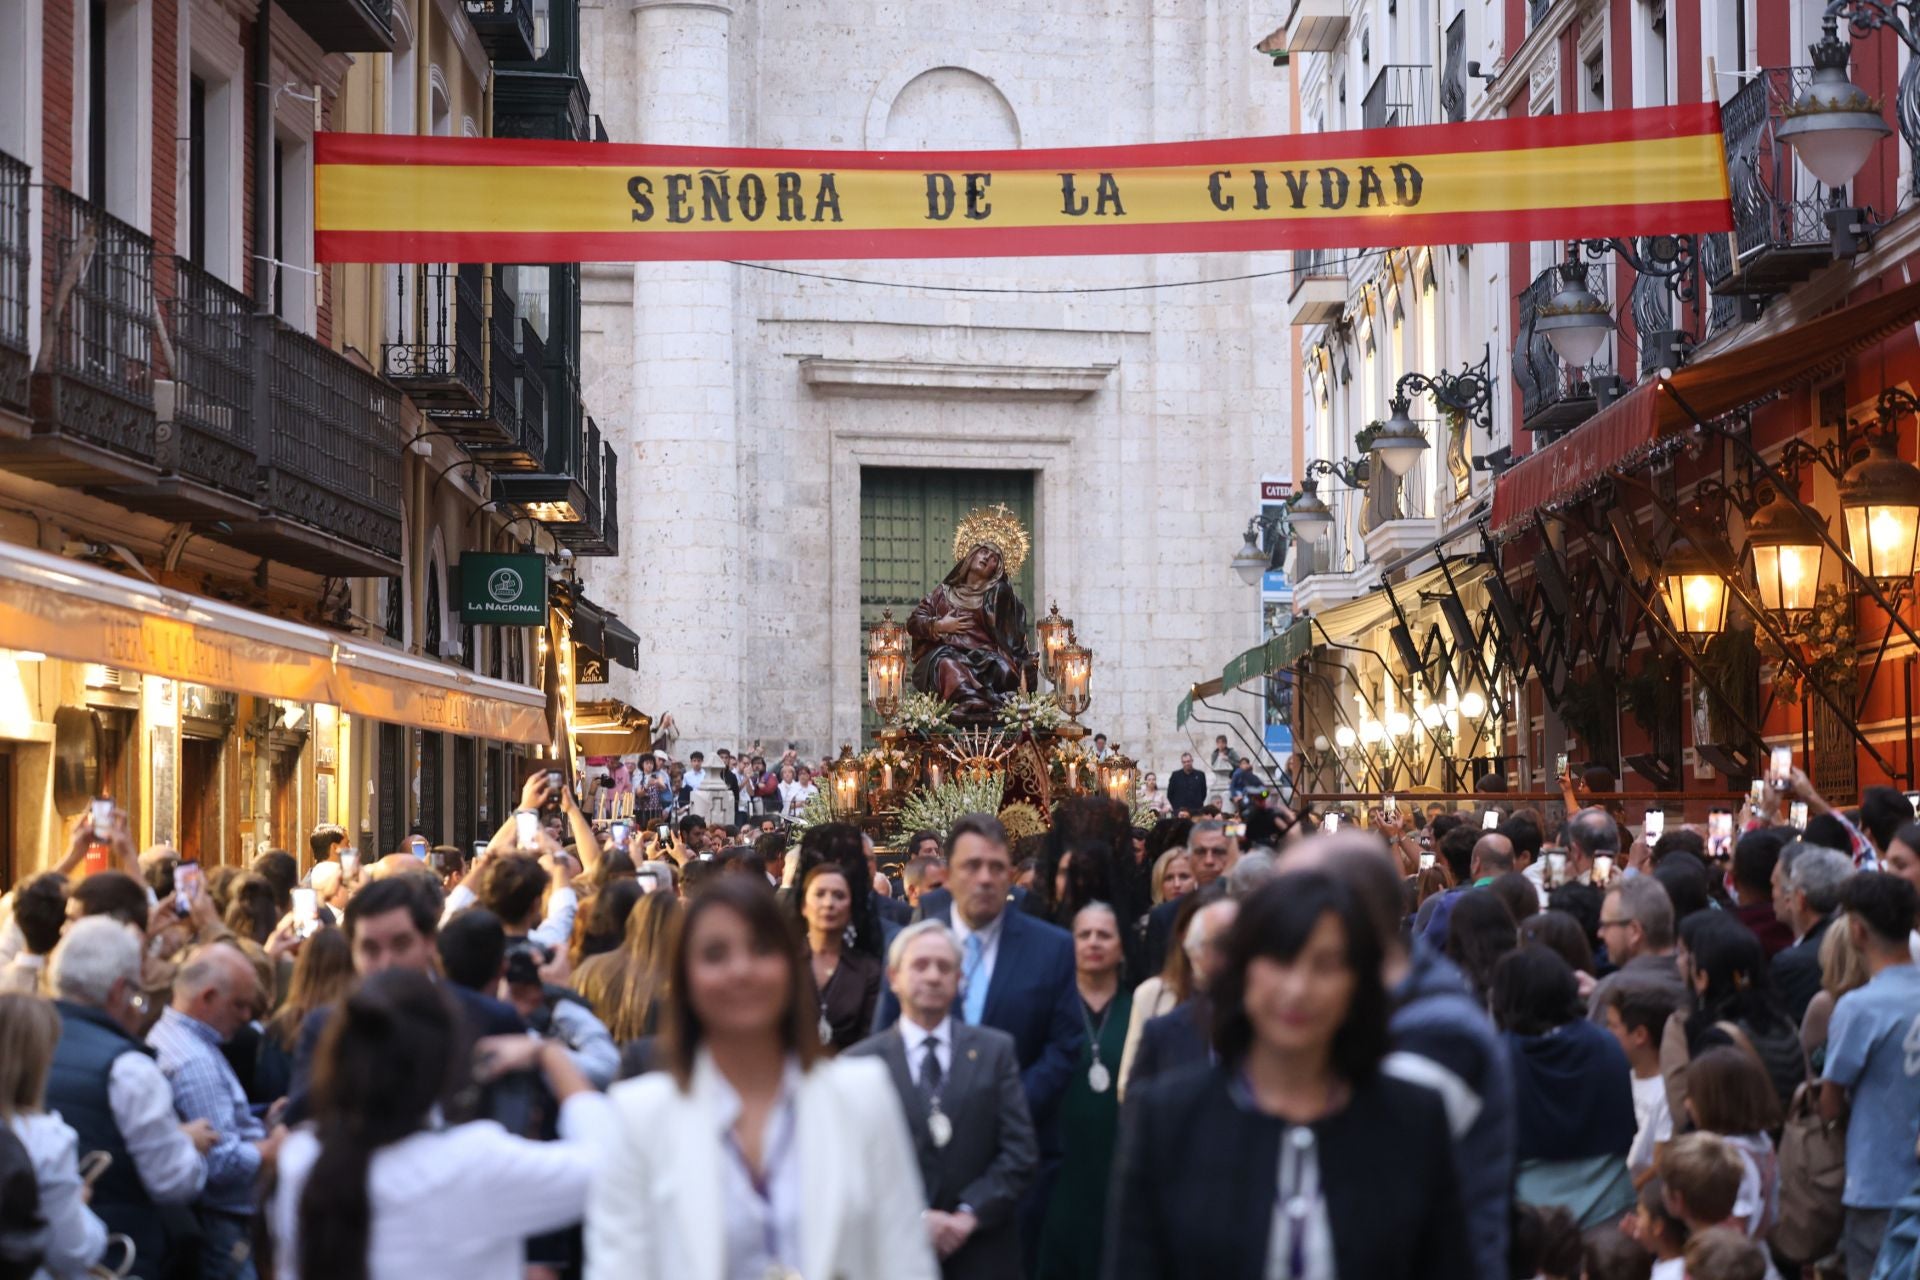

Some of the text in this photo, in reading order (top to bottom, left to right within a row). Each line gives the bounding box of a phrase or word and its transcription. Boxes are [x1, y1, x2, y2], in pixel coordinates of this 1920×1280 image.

[627, 163, 1424, 224] SEÑORA DE LA CIVDAD
[485, 602, 540, 612] NACIONAL
